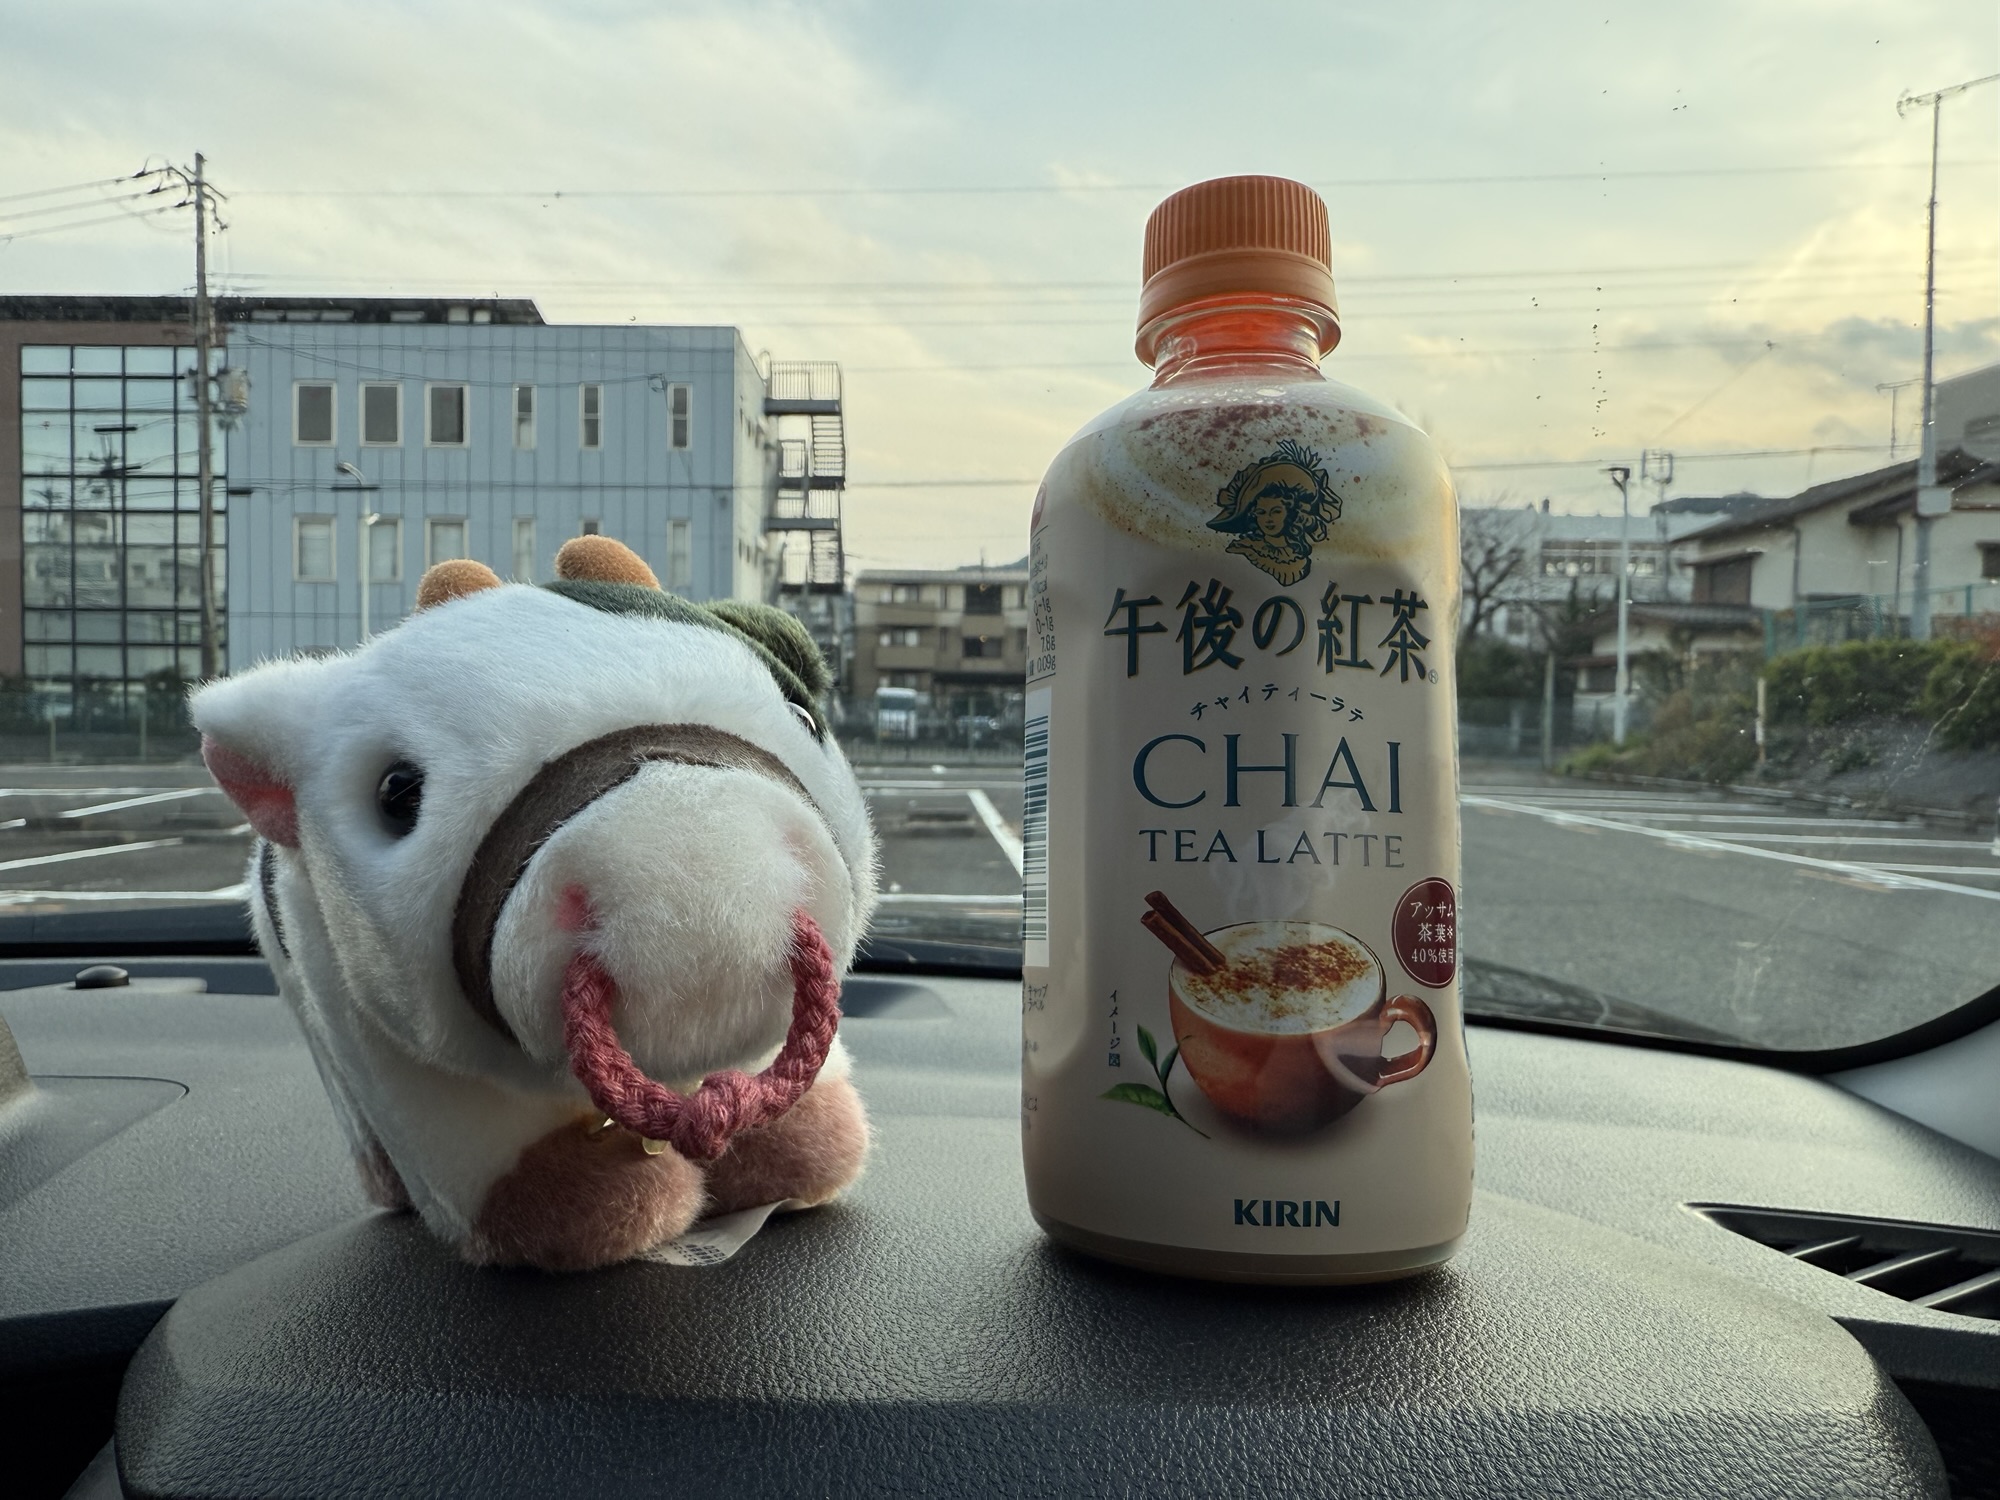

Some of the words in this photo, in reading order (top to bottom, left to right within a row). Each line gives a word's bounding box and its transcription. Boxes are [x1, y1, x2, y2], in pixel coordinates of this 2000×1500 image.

[1190, 683, 1364, 721] チャイティーラテ
[1133, 733, 1403, 813] CHAI
[1139, 829, 1238, 863] TEA
[1257, 829, 1405, 868] LATTE
[1234, 1198, 1341, 1228] KIRIN
